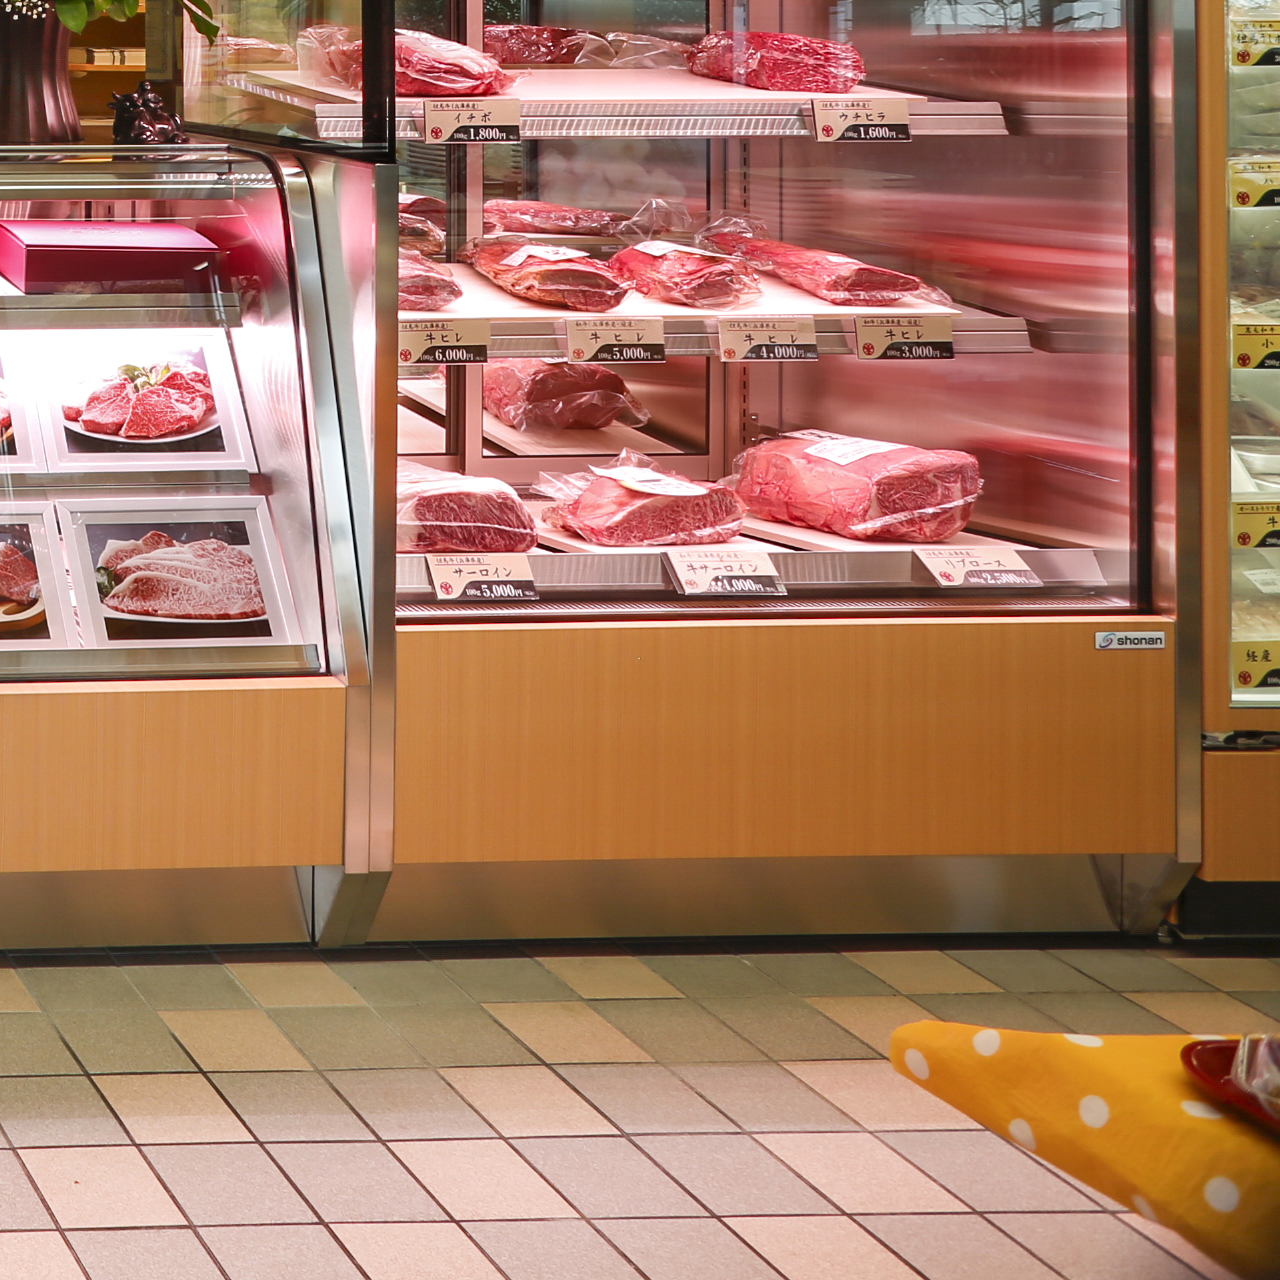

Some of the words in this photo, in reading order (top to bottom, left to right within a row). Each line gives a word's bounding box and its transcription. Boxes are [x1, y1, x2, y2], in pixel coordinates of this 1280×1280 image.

[454, 112, 492, 123] イチボ
[840, 112, 886, 122] ウチヒラ
[470, 128, 506, 140] 1,800円
[860, 127, 896, 139] 1,600円
[424, 332, 463, 344] 牛ヒレ
[590, 332, 644, 344] 牛ヒレ
[744, 333, 798, 345] 牛ヒレ
[884, 329, 924, 341] 牛ヒレ
[436, 349, 473, 362] 6,000円
[613, 348, 650, 360] 5,000円
[760, 346, 804, 359] 4,000円
[902, 346, 939, 358] 3,000円
[687, 564, 758, 574] 牛サーロイン
[944, 559, 1006, 569] リブロース
[453, 567, 511, 578] サーロイン
[982, 573, 1028, 584] 2,500円
[481, 584, 522, 598] 5,000円
[1117, 635, 1162, 645] shonan
